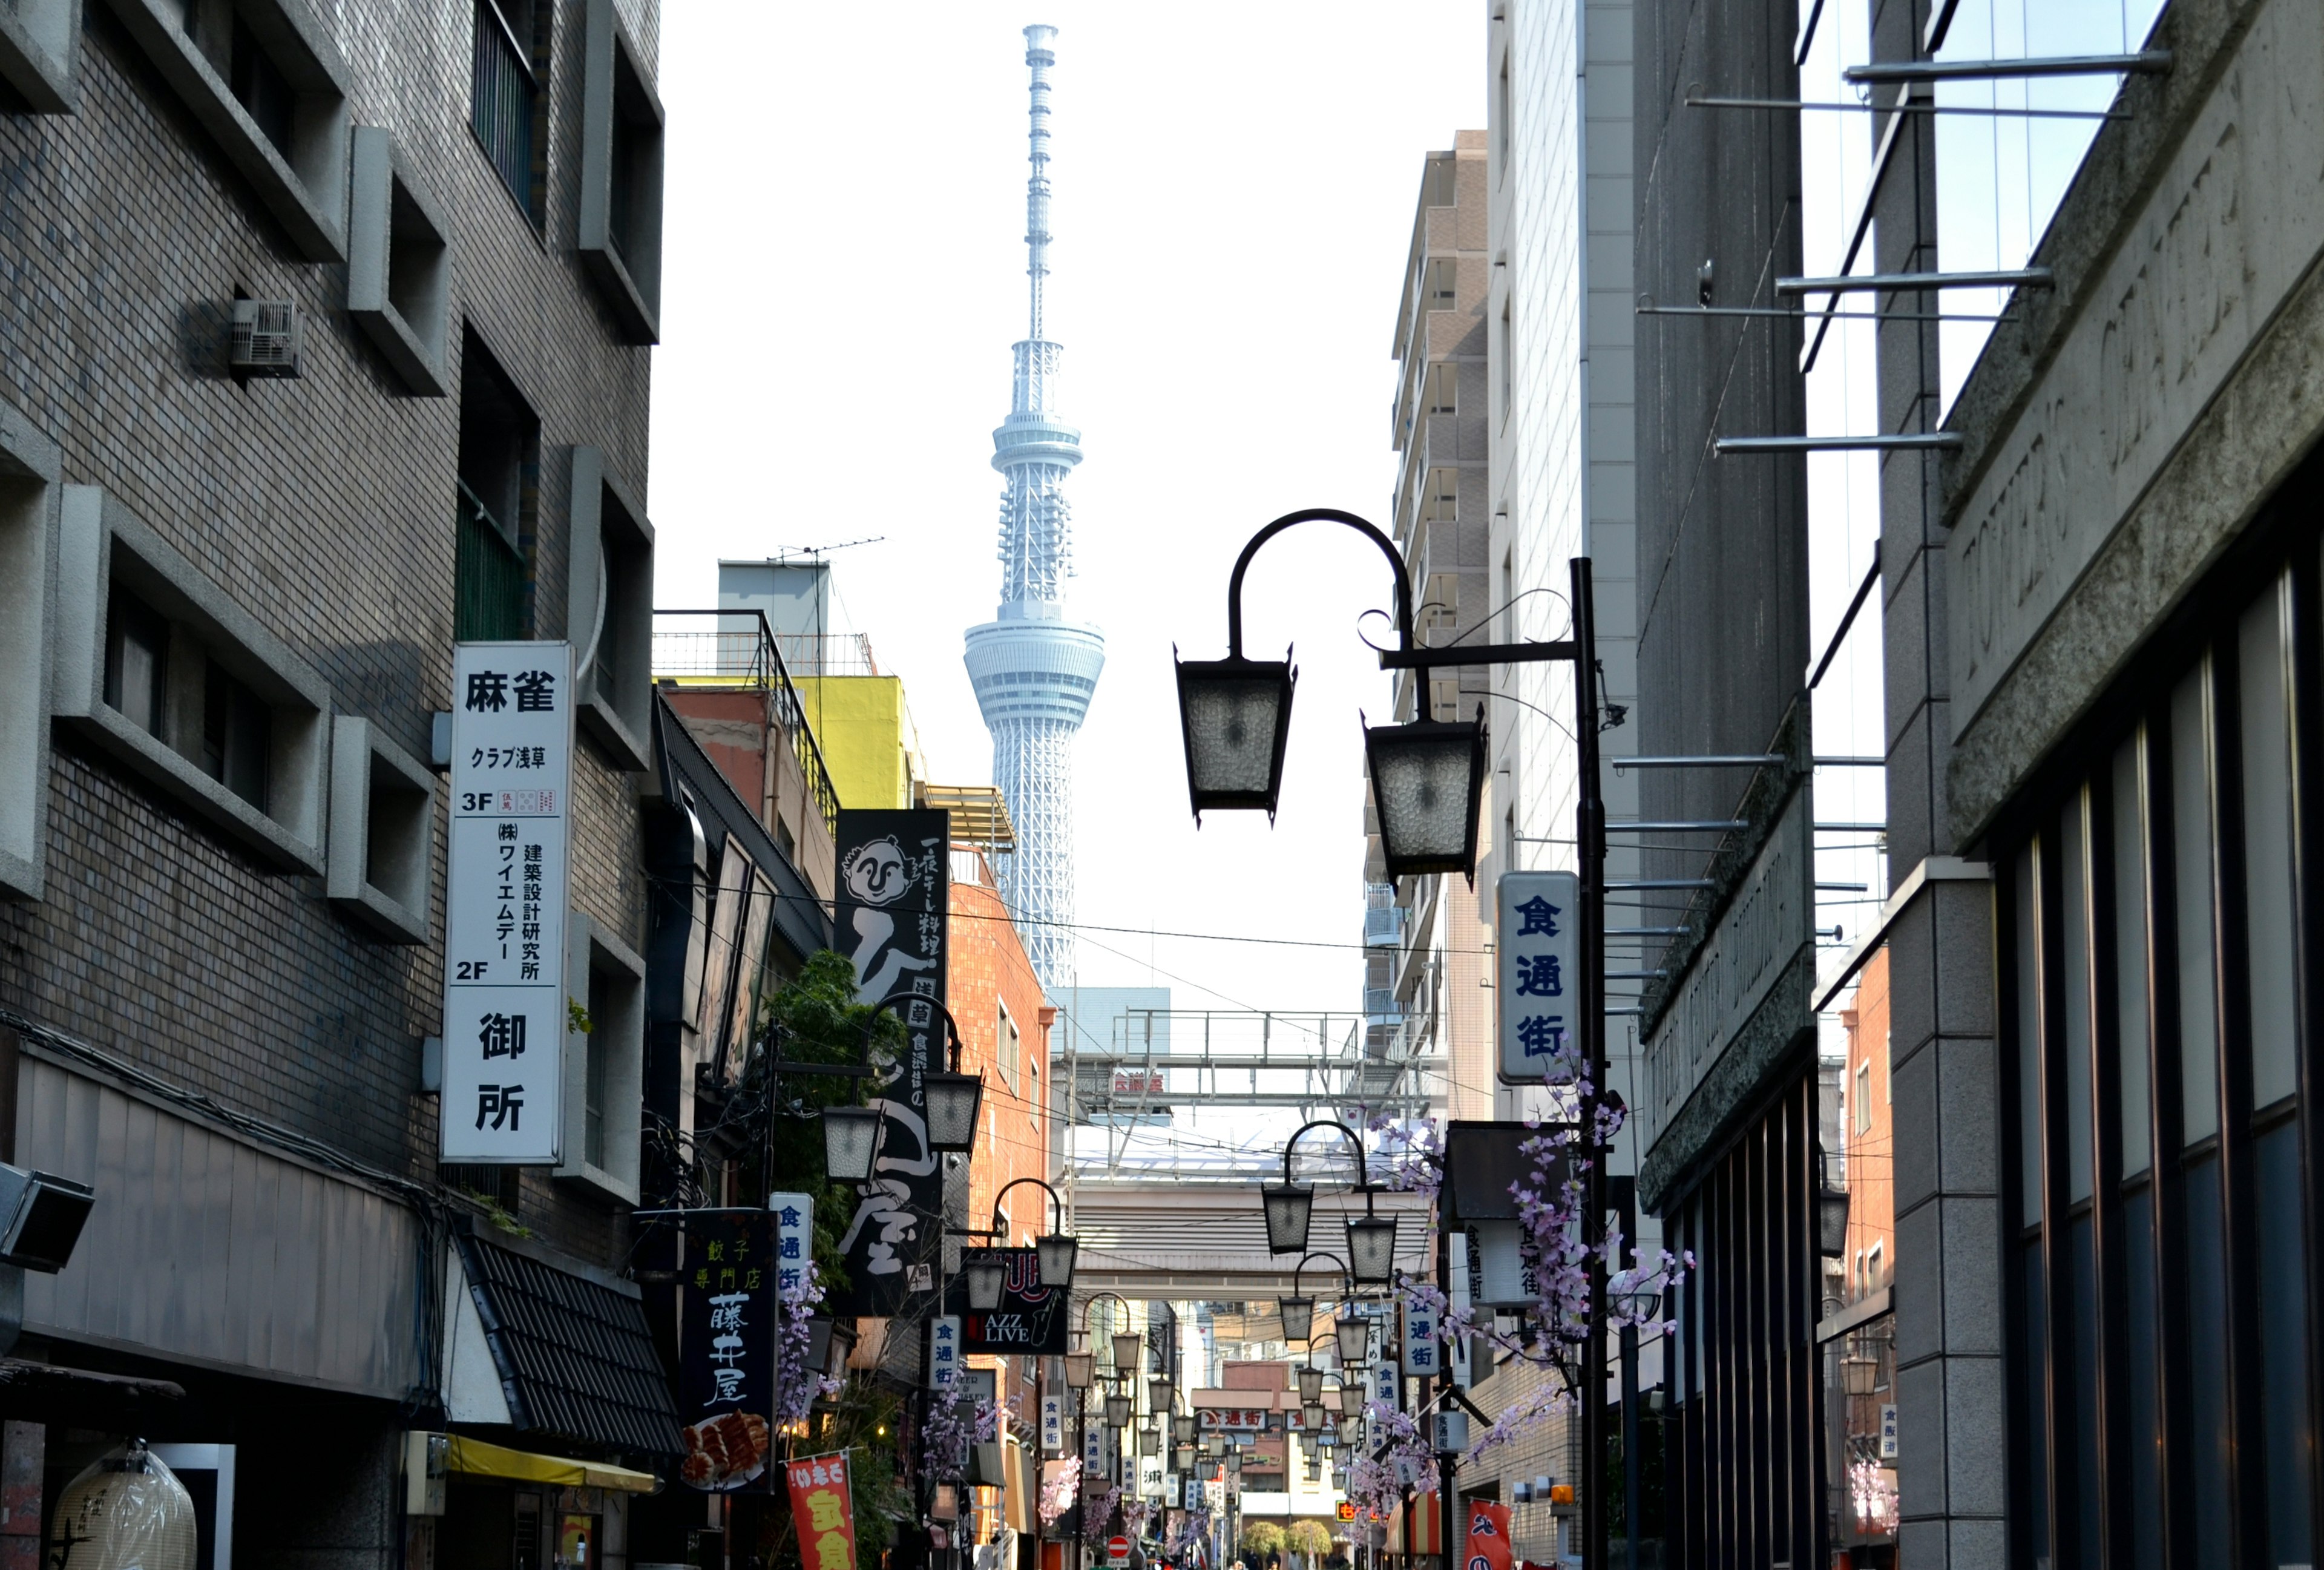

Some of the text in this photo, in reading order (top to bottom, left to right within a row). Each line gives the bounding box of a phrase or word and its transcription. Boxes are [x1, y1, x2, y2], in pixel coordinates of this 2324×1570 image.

[465, 671, 556, 712] 麻雀
[472, 746, 545, 769] クラブ浅草
[462, 793, 493, 811] 3F
[521, 844, 543, 980] 建築設計研究所
[918, 838, 940, 956] 一夜干し料理
[456, 962, 488, 980] 2F
[1515, 895, 1564, 1058] 食通街
[475, 1012, 527, 1132] 御所
[707, 1240, 749, 1261] 餃子
[1466, 1224, 1483, 1299] 食通街
[703, 1291, 750, 1407] 藤井屋
[936, 1324, 953, 1384] 食通街
[985, 1328, 1029, 1342] LIVE
[958, 1393, 986, 1401] ISKEY
[1379, 1368, 1394, 1410] 食通
[1046, 1401, 1057, 1444] 食通街
[1206, 1411, 1261, 1426] 食通街
[1439, 1415, 1448, 1448] 食通街
[1088, 1432, 1098, 1470] 食通街
[1125, 1460, 1134, 1491] 食通街
